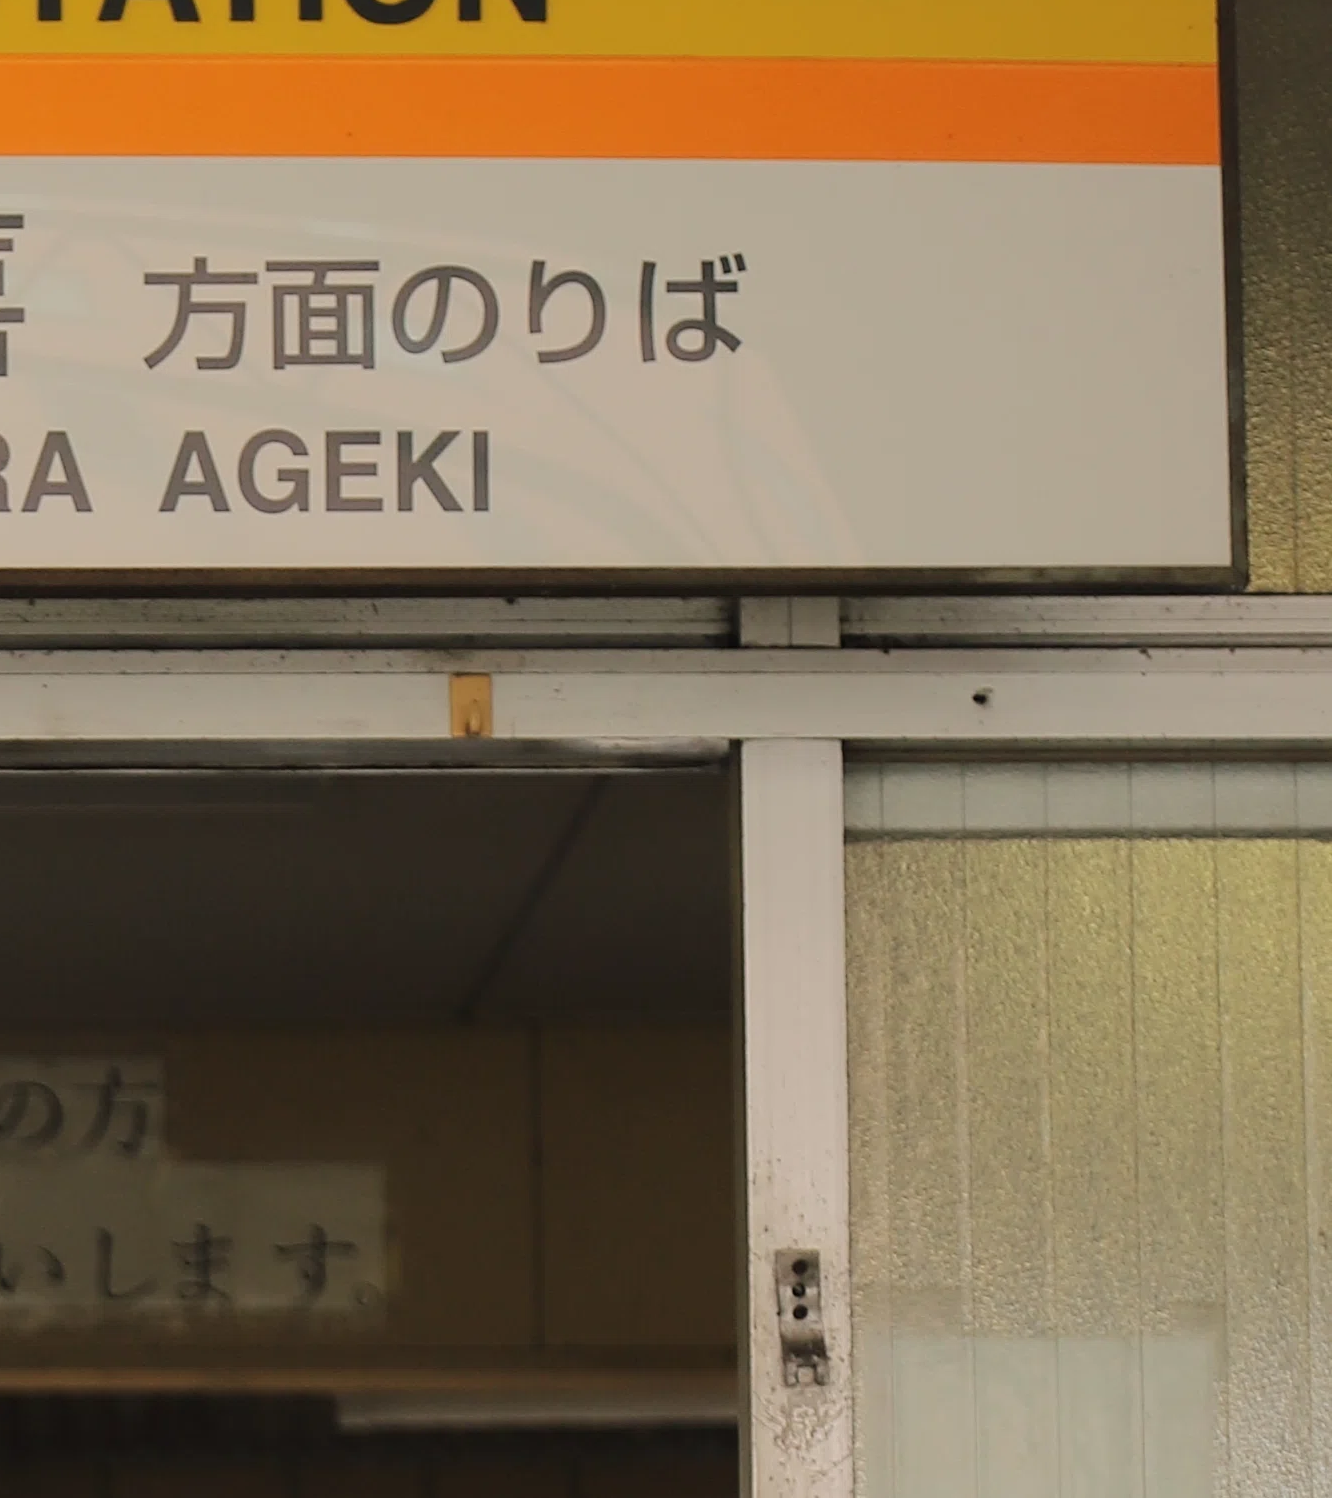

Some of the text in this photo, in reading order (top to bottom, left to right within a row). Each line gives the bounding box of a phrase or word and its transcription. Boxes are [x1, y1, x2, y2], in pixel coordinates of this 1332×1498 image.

[141, 252, 747, 372] 方面のりば
[157, 427, 493, 514] AGEKI
